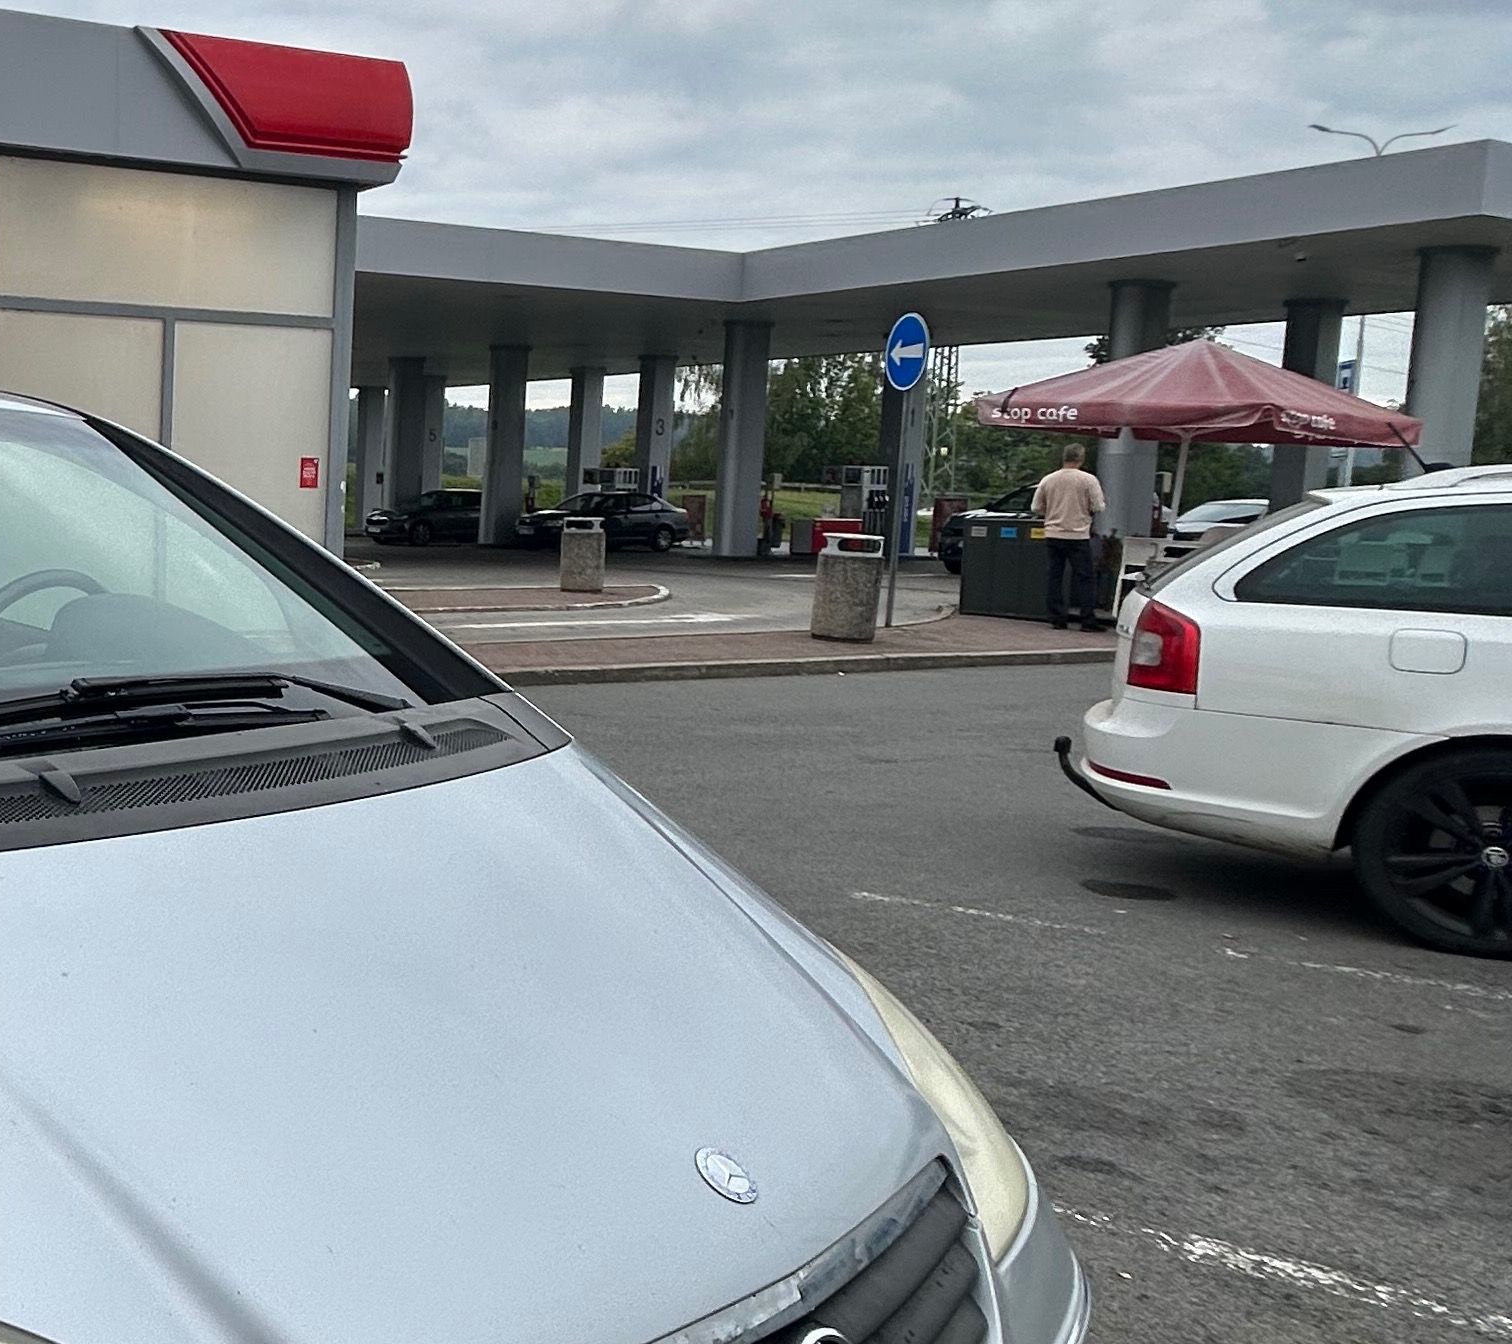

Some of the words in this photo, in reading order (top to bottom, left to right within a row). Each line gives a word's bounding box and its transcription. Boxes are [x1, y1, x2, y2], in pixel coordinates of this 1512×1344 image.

[1037, 405, 1078, 422] cafe
[428, 428, 437, 443] 5
[655, 418, 665, 436] 3
